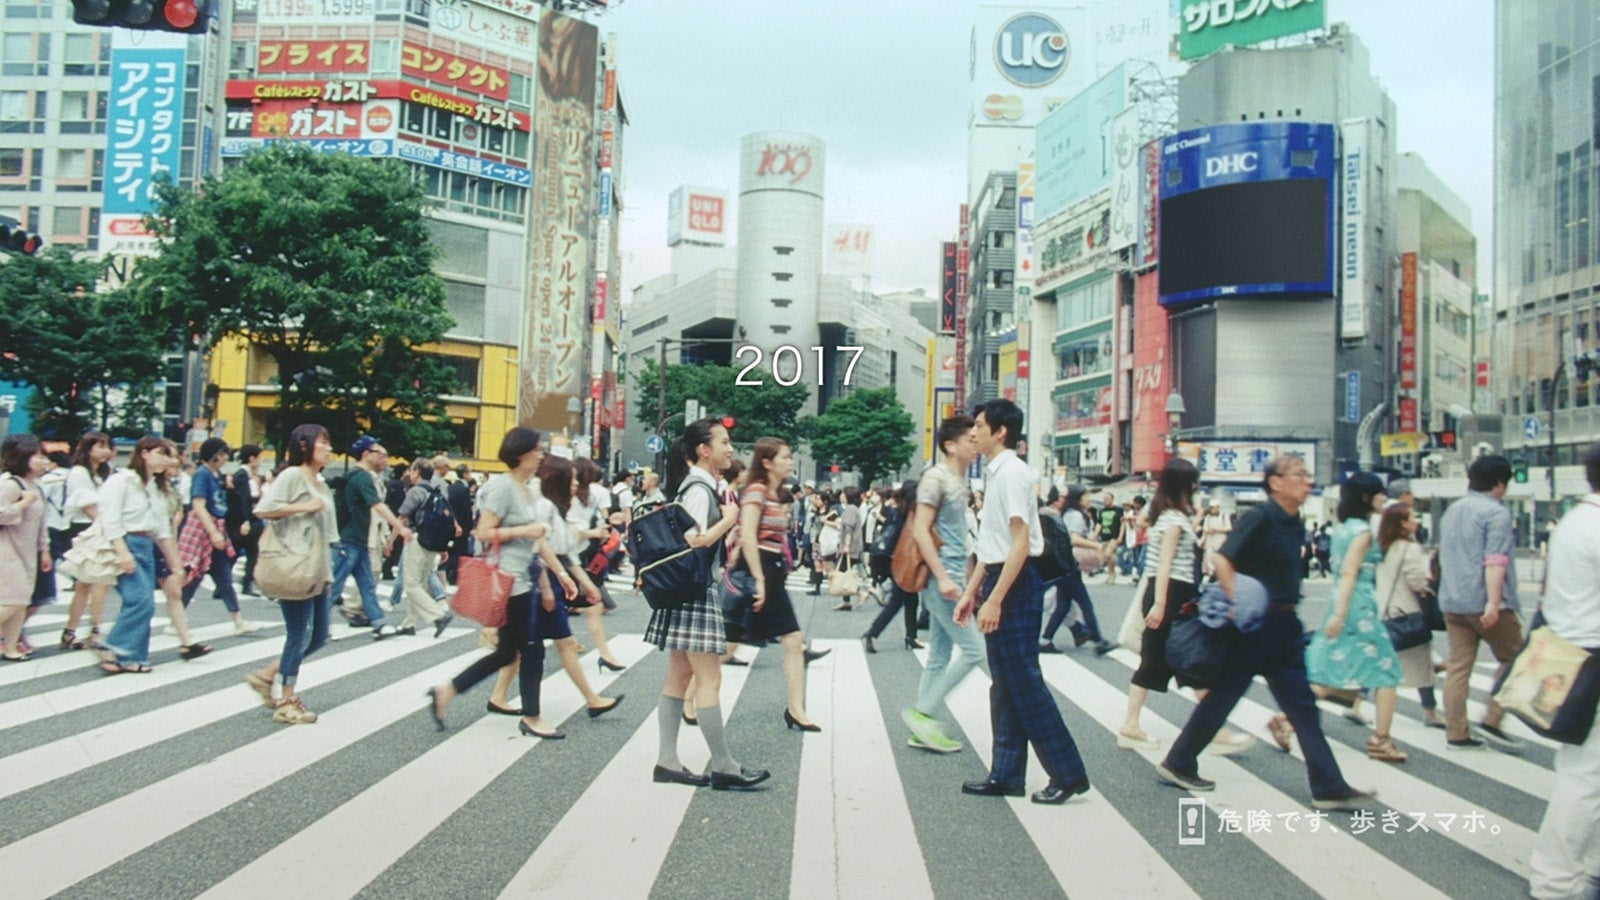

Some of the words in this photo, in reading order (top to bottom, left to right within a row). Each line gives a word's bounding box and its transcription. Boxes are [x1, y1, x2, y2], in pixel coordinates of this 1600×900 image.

[260, 43, 367, 66] プライス
[402, 46, 505, 91] コンタクト
[323, 81, 377, 101] ガスト
[113, 62, 150, 202] アイシティ
[227, 111, 253, 129] 7F
[289, 108, 357, 136] ガスト
[474, 103, 521, 130] ガスト
[441, 151, 530, 183] 英会話イーオン
[756, 149, 812, 184] 109
[1205, 152, 1258, 177] DHC
[1347, 148, 1361, 217] Taisei
[555, 130, 582, 389] リニューアルオープン
[1346, 222, 1358, 280] neon
[539, 277, 552, 318] open
[540, 323, 552, 343] 24
